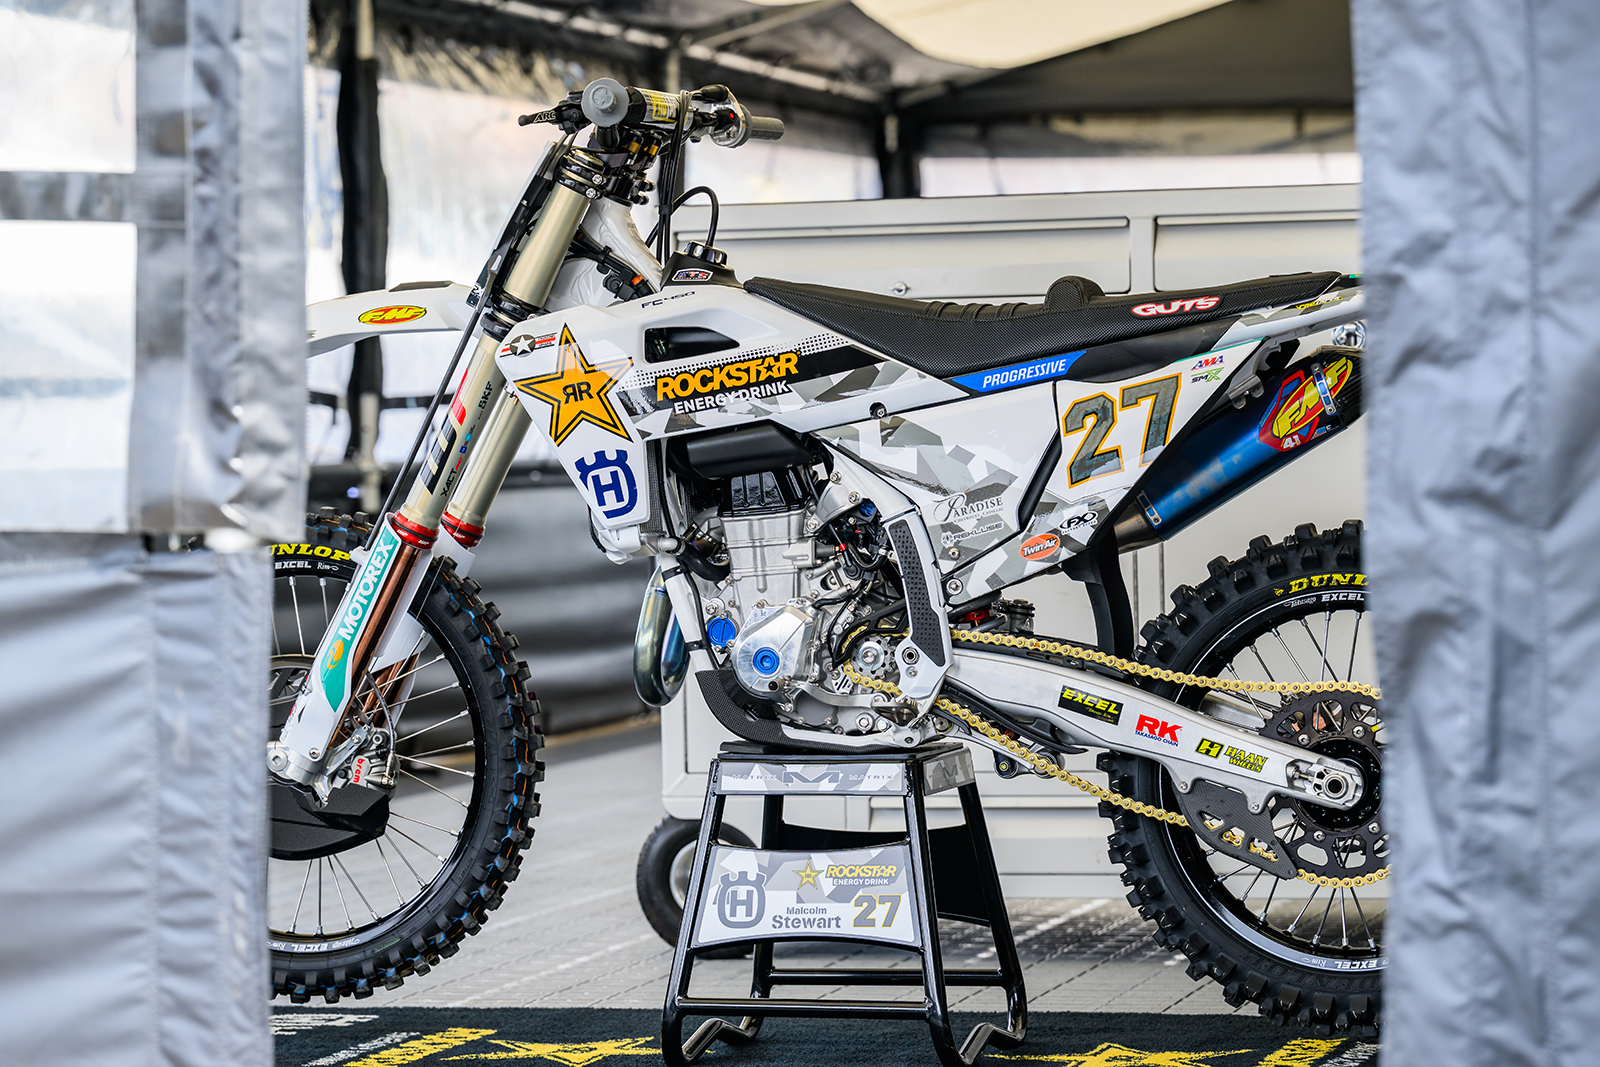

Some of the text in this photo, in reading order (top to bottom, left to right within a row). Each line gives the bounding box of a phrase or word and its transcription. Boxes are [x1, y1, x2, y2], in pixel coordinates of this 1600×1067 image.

[533, 110, 556, 123] ARC
[359, 306, 426, 322] FMF
[1131, 296, 1221, 317] GUTS
[1191, 355, 1224, 370] AMA
[656, 352, 799, 402] ROCKSTAR
[982, 358, 1067, 388] PROGRESSIVE
[477, 381, 493, 410] SKF
[673, 380, 790, 415] ENERGY DRINK
[1062, 372, 1183, 489] 27
[440, 467, 457, 497] XACT
[932, 493, 1004, 522] PARADISE
[1022, 537, 1058, 557] Twin Air
[274, 560, 312, 570] EXCEL
[338, 539, 394, 641] MOTOREX
[1321, 593, 1365, 602] EXCEL
[1062, 688, 1119, 715] EXCEL
[1136, 714, 1183, 743] RK
[1135, 730, 1179, 748] TAKASAGO CHAIN
[1224, 746, 1268, 767] HAAN
[1229, 757, 1263, 773] WHEELS
[826, 865, 898, 878] ROCKSTAR
[833, 878, 862, 886] ENERGY
[786, 906, 827, 915] Malcolm
[852, 894, 902, 929] 27
[771, 914, 842, 930] Stewart
[291, 943, 328, 952] EXCEL
[1334, 960, 1378, 969] EXCEL
